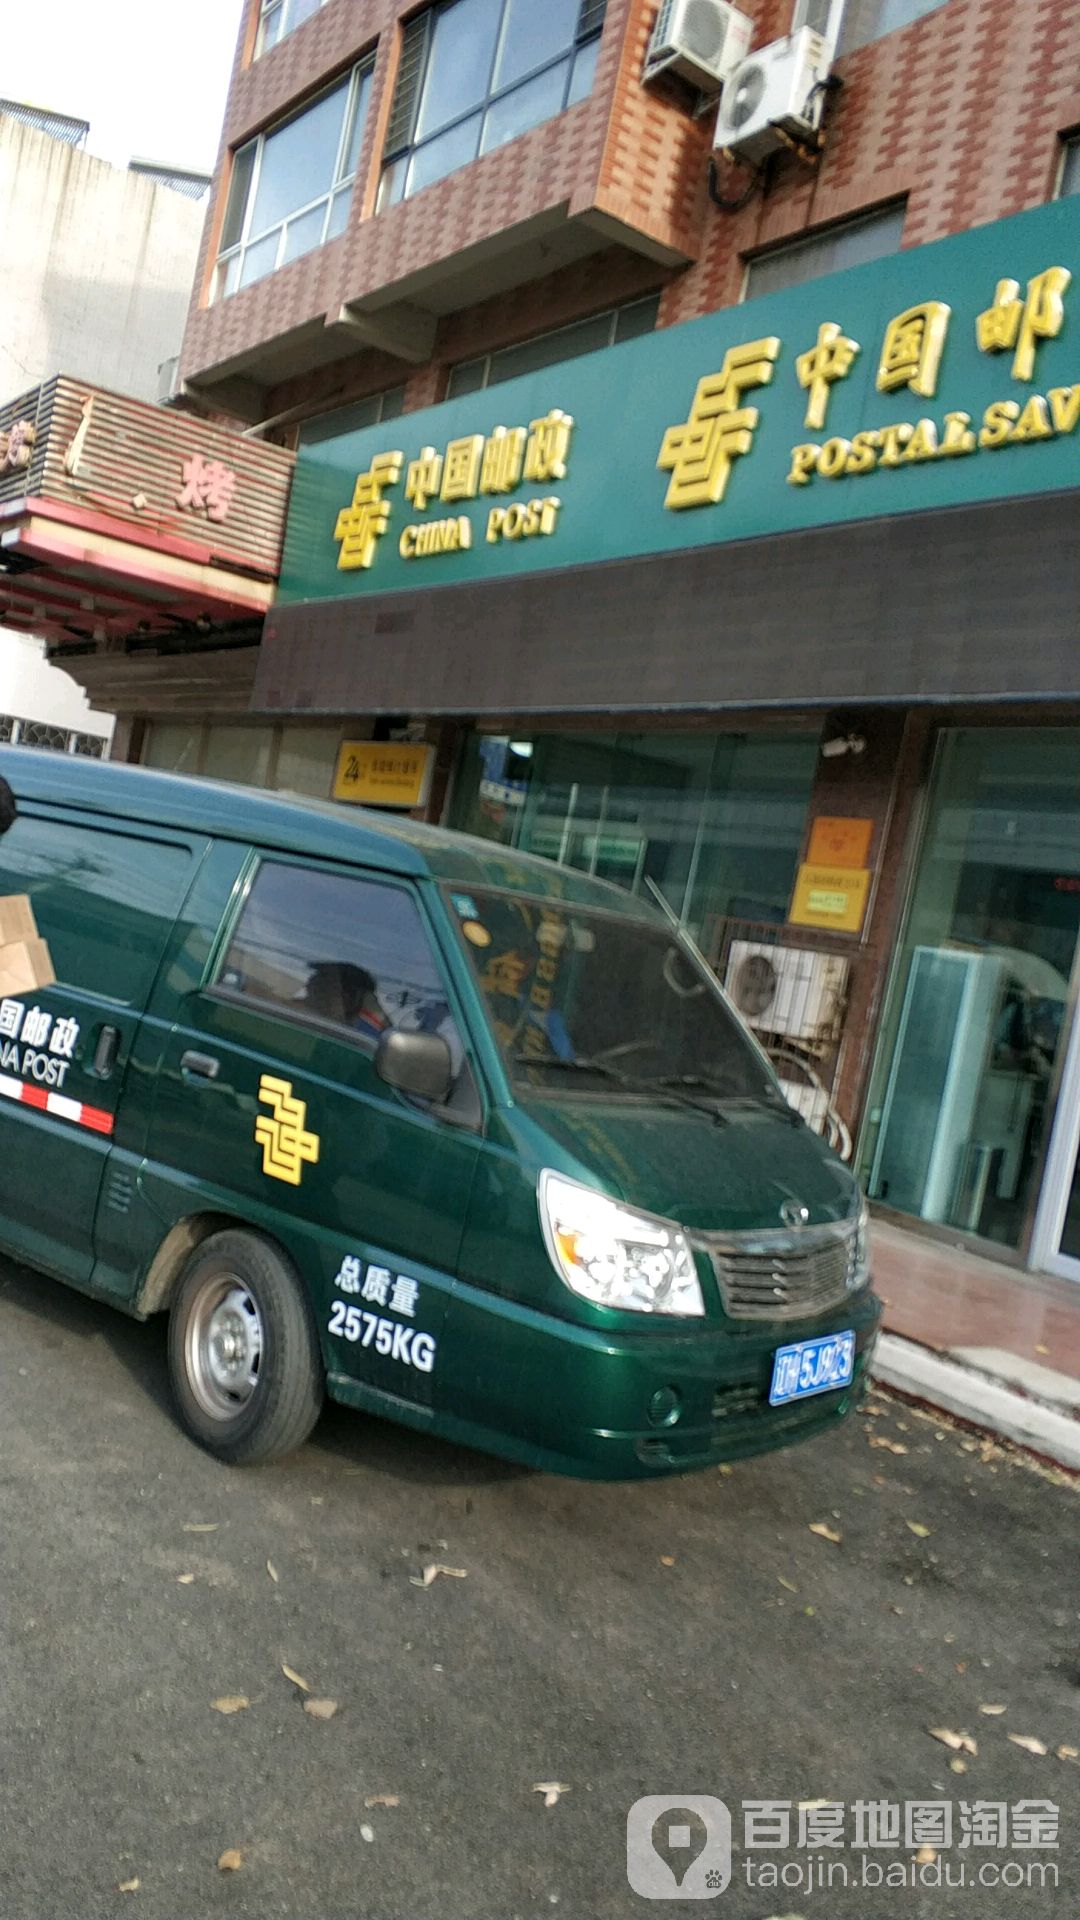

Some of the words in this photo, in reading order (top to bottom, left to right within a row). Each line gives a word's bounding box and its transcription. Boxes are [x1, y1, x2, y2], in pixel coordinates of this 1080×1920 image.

[797, 265, 1072, 429] 中国邮
[405, 408, 574, 510] 中国邮政
[787, 411, 976, 485] POSTAL
[978, 383, 1080, 447] SAV
[400, 515, 472, 559] CHINA
[486, 496, 561, 543] POST
[22, 1049, 70, 1088] POST
[334, 1255, 419, 1318] 总质量
[327, 1300, 436, 1373] 2575KG
